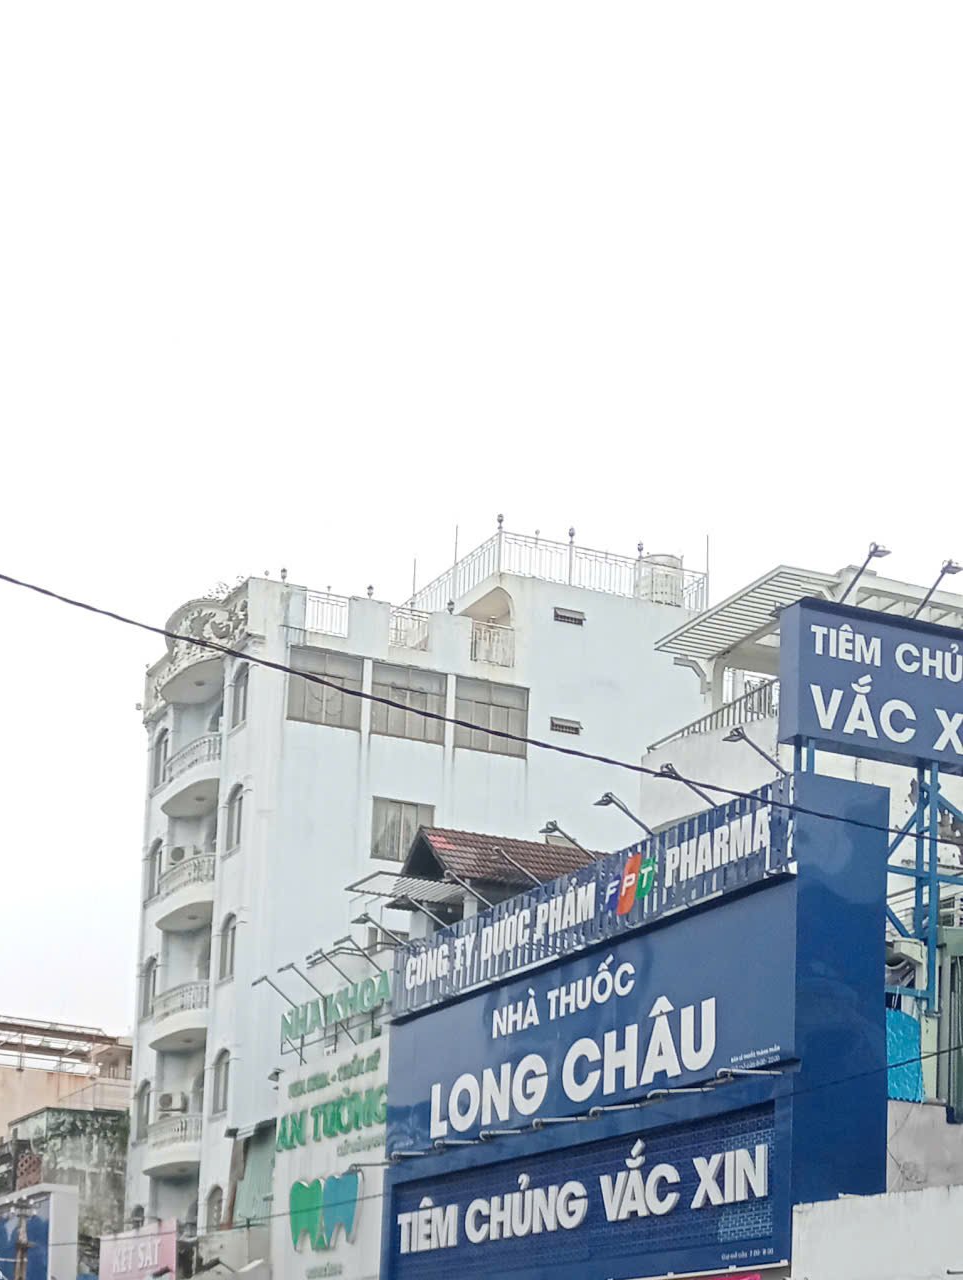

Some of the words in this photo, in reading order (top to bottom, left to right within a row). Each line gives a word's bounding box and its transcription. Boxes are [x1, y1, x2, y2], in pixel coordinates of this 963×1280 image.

[810, 623, 882, 667] TIÊM
[810, 674, 917, 743] VẮC
[404, 939, 450, 990] CÔNG
[454, 930, 477, 972] TY
[480, 910, 531, 963] DƯỢC
[536, 878, 596, 940] PHẨM
[604, 857, 657, 910] FPT
[664, 808, 770, 888] PHARMA
[325, 970, 391, 1026] KHOA
[492, 988, 540, 1039] NHÀ
[547, 954, 636, 1021] THUỐC
[430, 1054, 549, 1140] LONG
[562, 995, 717, 1103] CHÂU
[396, 1196, 459, 1255] TIÊM
[464, 1173, 589, 1244] CHỦNG
[599, 1138, 682, 1222] VẮC
[691, 1143, 770, 1210] XIN
